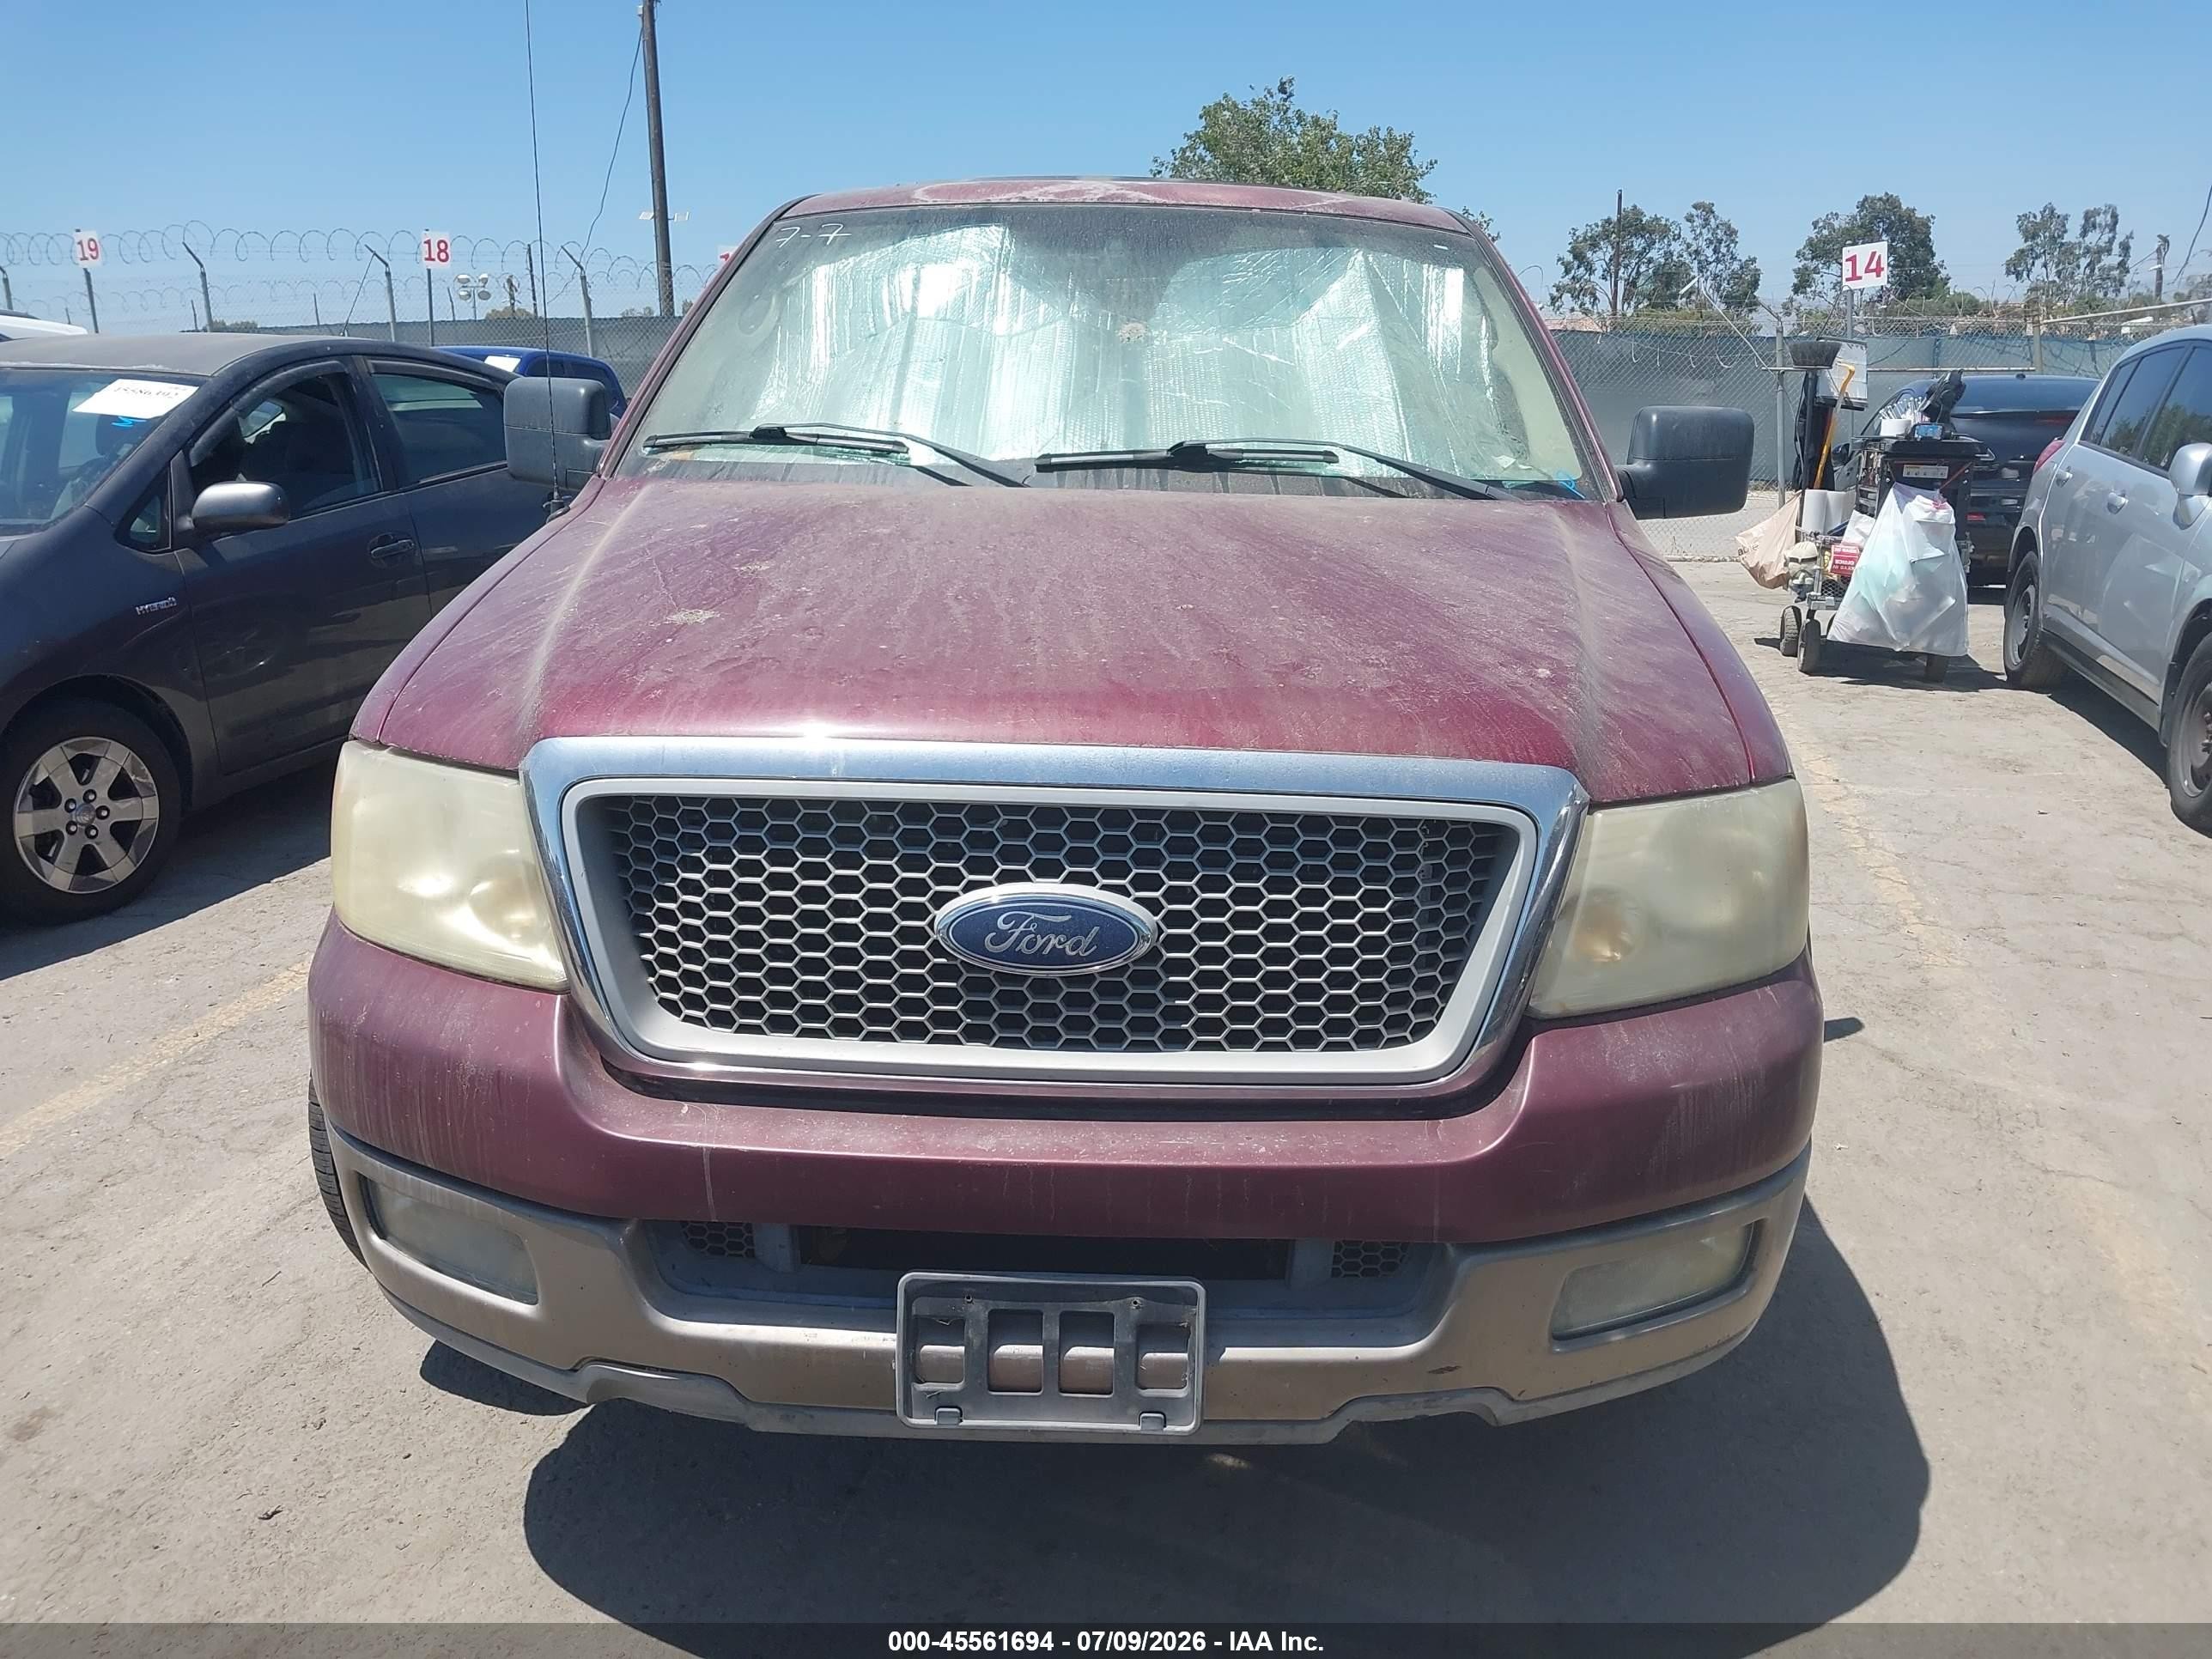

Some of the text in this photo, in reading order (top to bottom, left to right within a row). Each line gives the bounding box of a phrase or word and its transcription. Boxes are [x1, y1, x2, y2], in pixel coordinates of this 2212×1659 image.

[775, 223, 852, 248] 7-7
[77, 238, 99, 261] 19
[423, 239, 449, 262] 18
[1845, 251, 1884, 282] 14
[984, 911, 1100, 957] Ford
